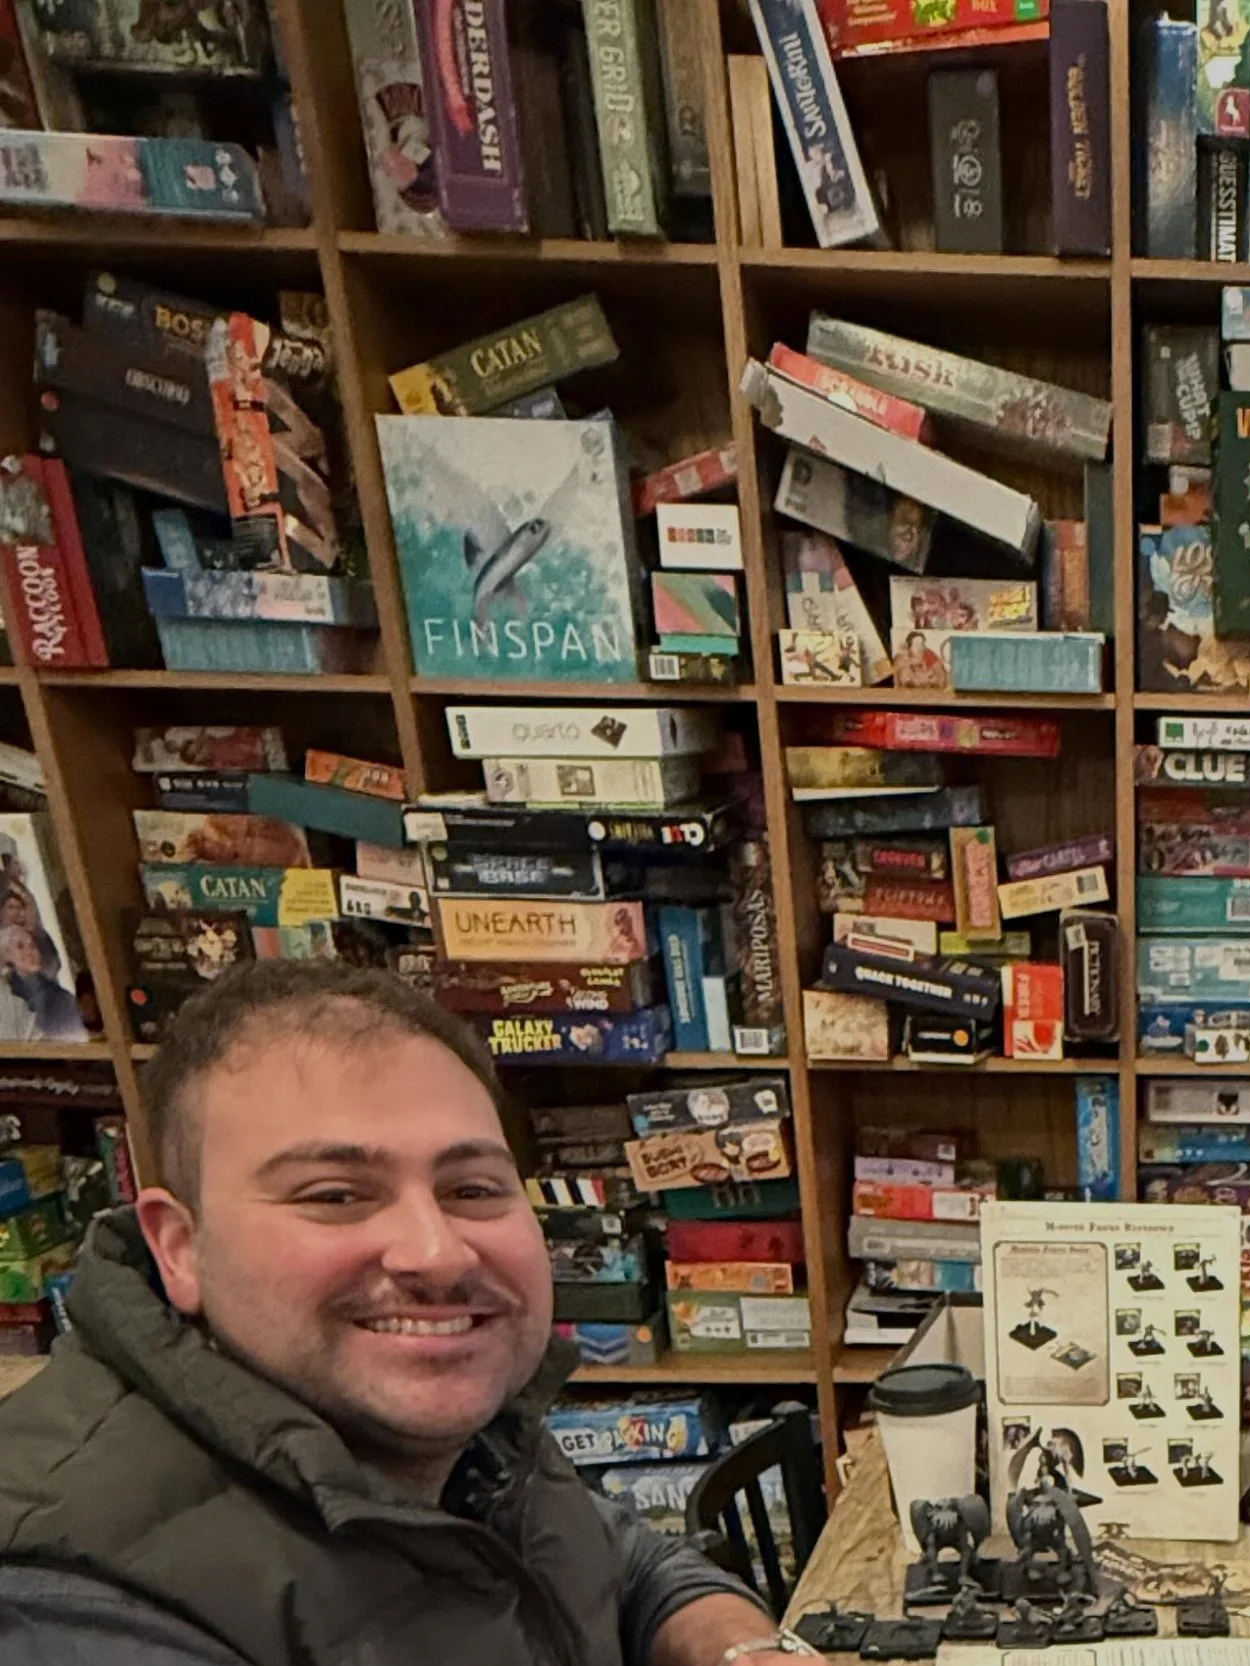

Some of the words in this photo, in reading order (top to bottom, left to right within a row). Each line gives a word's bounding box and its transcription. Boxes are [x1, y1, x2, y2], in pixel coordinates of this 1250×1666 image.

[465, 0, 501, 171] DERDASH
[1217, 151, 1239, 262] GUESSTIMAT
[470, 327, 543, 378] CATAN
[16, 545, 64, 661] RACCOON
[423, 618, 623, 661] FINSPAN
[1162, 751, 1246, 782] CLUE
[200, 874, 268, 900] CATAN
[455, 911, 577, 936] UNEARTH
[746, 889, 771, 1004] MARIPOSAS
[488, 1031, 563, 1055] TRUCKER
[491, 1019, 555, 1039] GALAXY
[561, 1432, 596, 1451] GET
